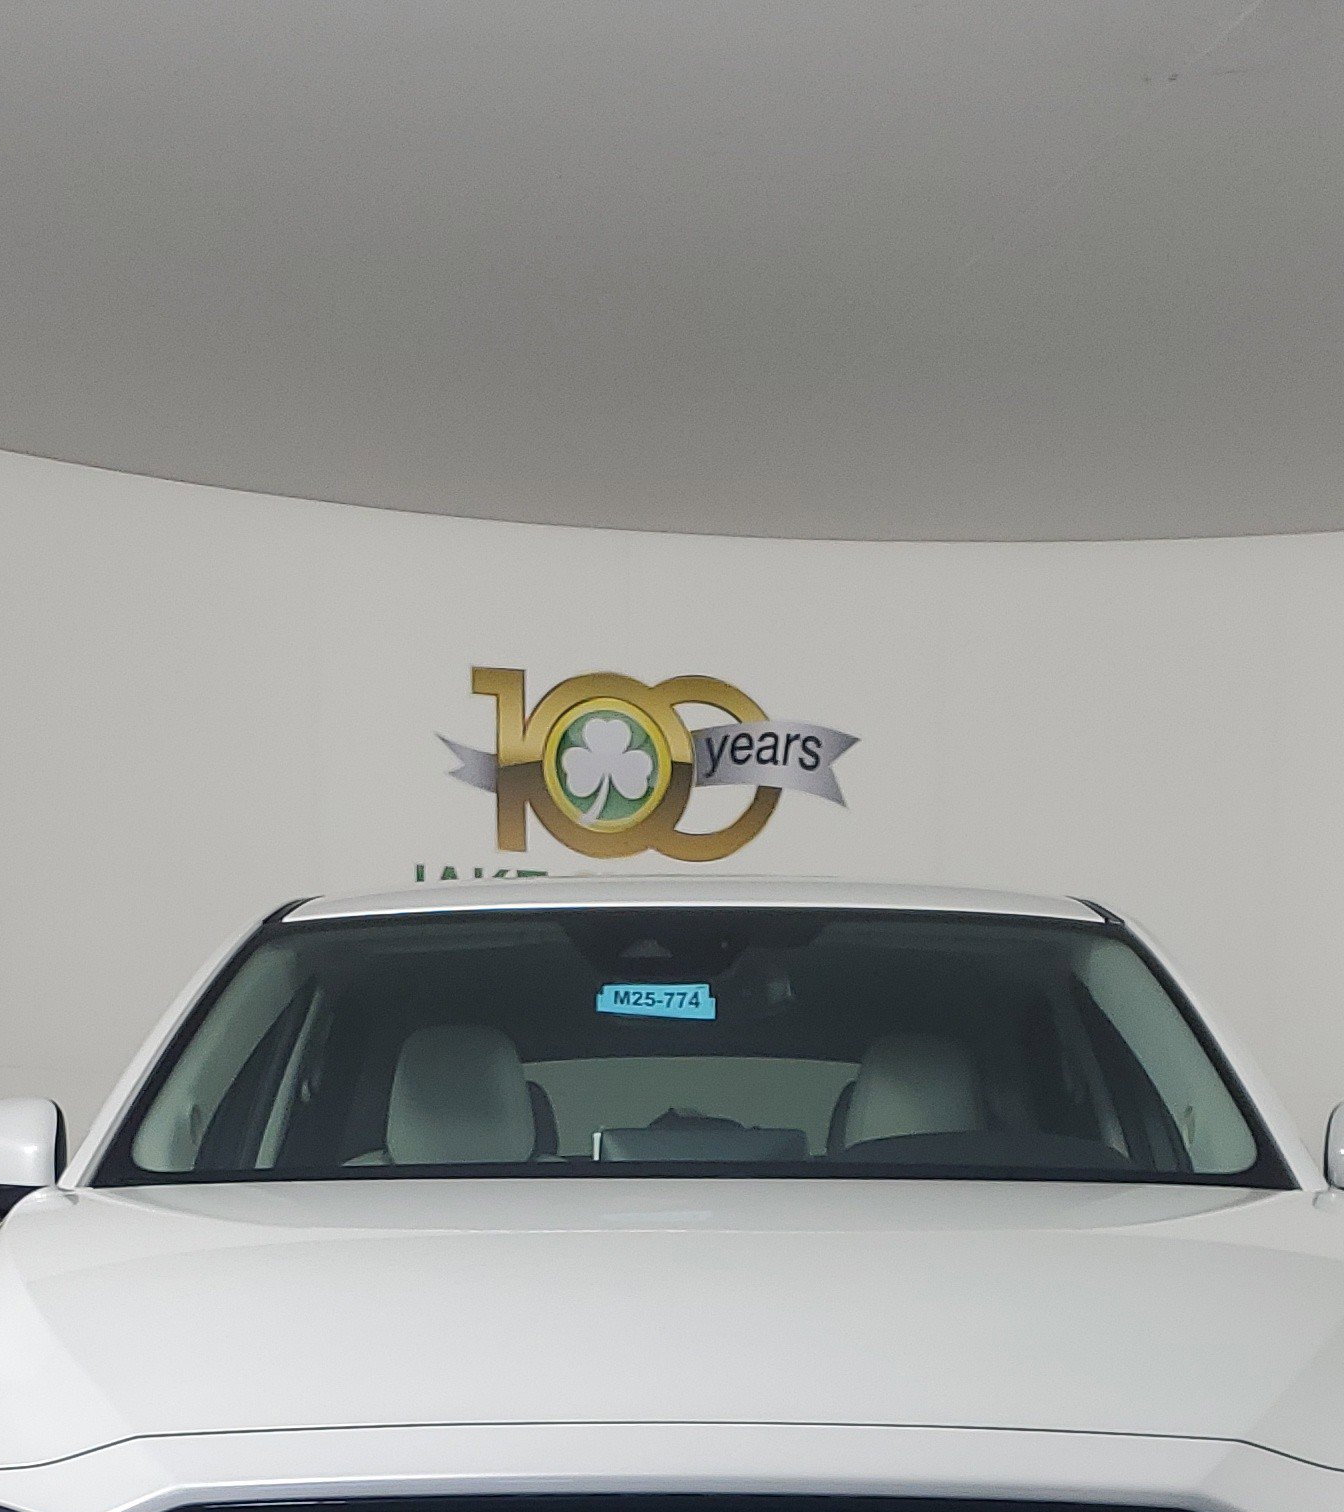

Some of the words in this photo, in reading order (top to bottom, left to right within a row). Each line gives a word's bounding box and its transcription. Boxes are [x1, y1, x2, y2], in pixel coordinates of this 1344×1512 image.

[471, 666, 783, 862] 100
[704, 730, 823, 778] years
[613, 989, 701, 1009] M25-774
